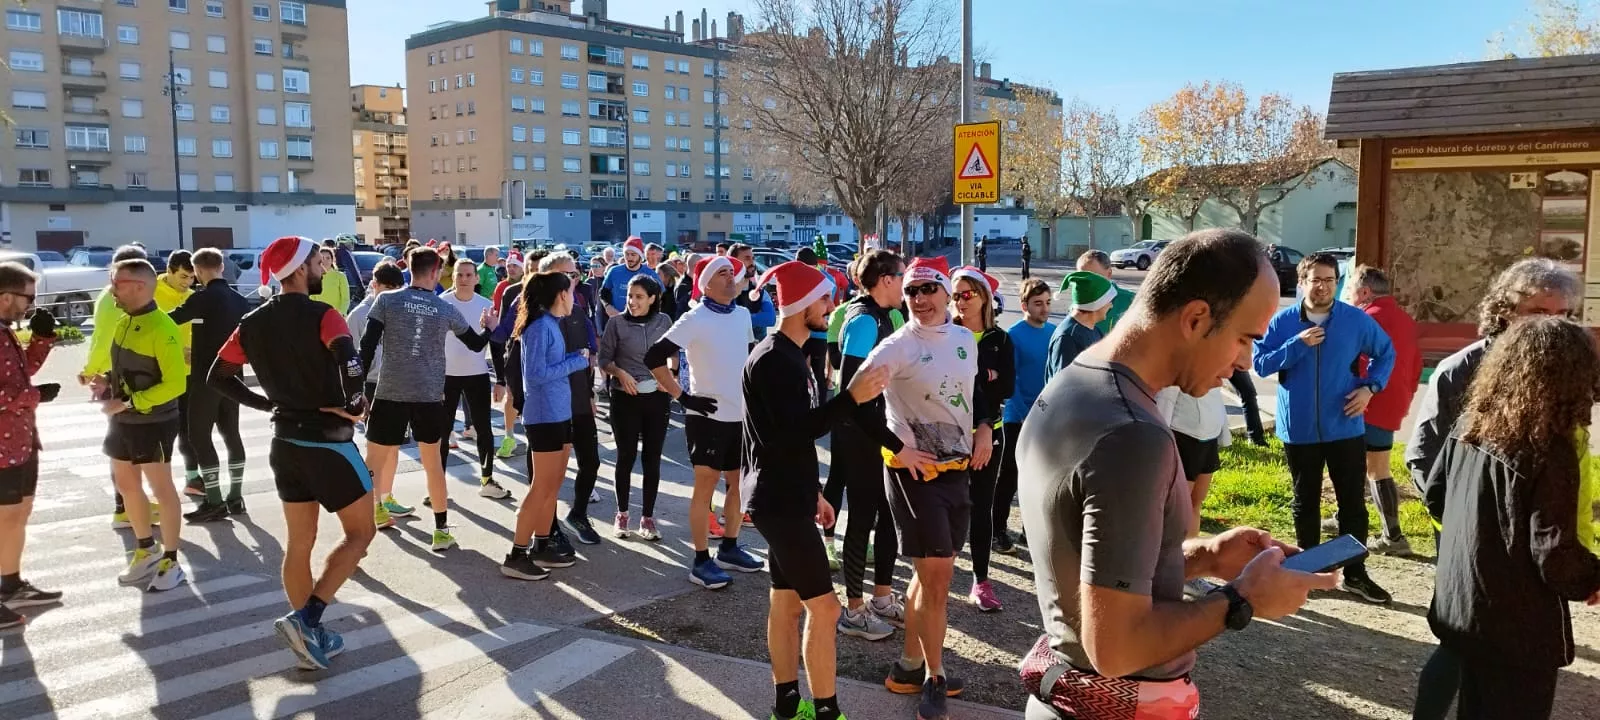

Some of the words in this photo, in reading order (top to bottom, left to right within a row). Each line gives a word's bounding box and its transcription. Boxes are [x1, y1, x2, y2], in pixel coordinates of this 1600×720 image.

[1391, 146, 1425, 155] Camino
[1426, 145, 1460, 153] Natural
[1462, 144, 1474, 152] de
[1476, 143, 1507, 152] Loreto
[1508, 144, 1515, 152] y
[1517, 142, 1532, 151] del
[1535, 141, 1589, 150] Canfranero
[957, 191, 995, 199] CICLABLE
